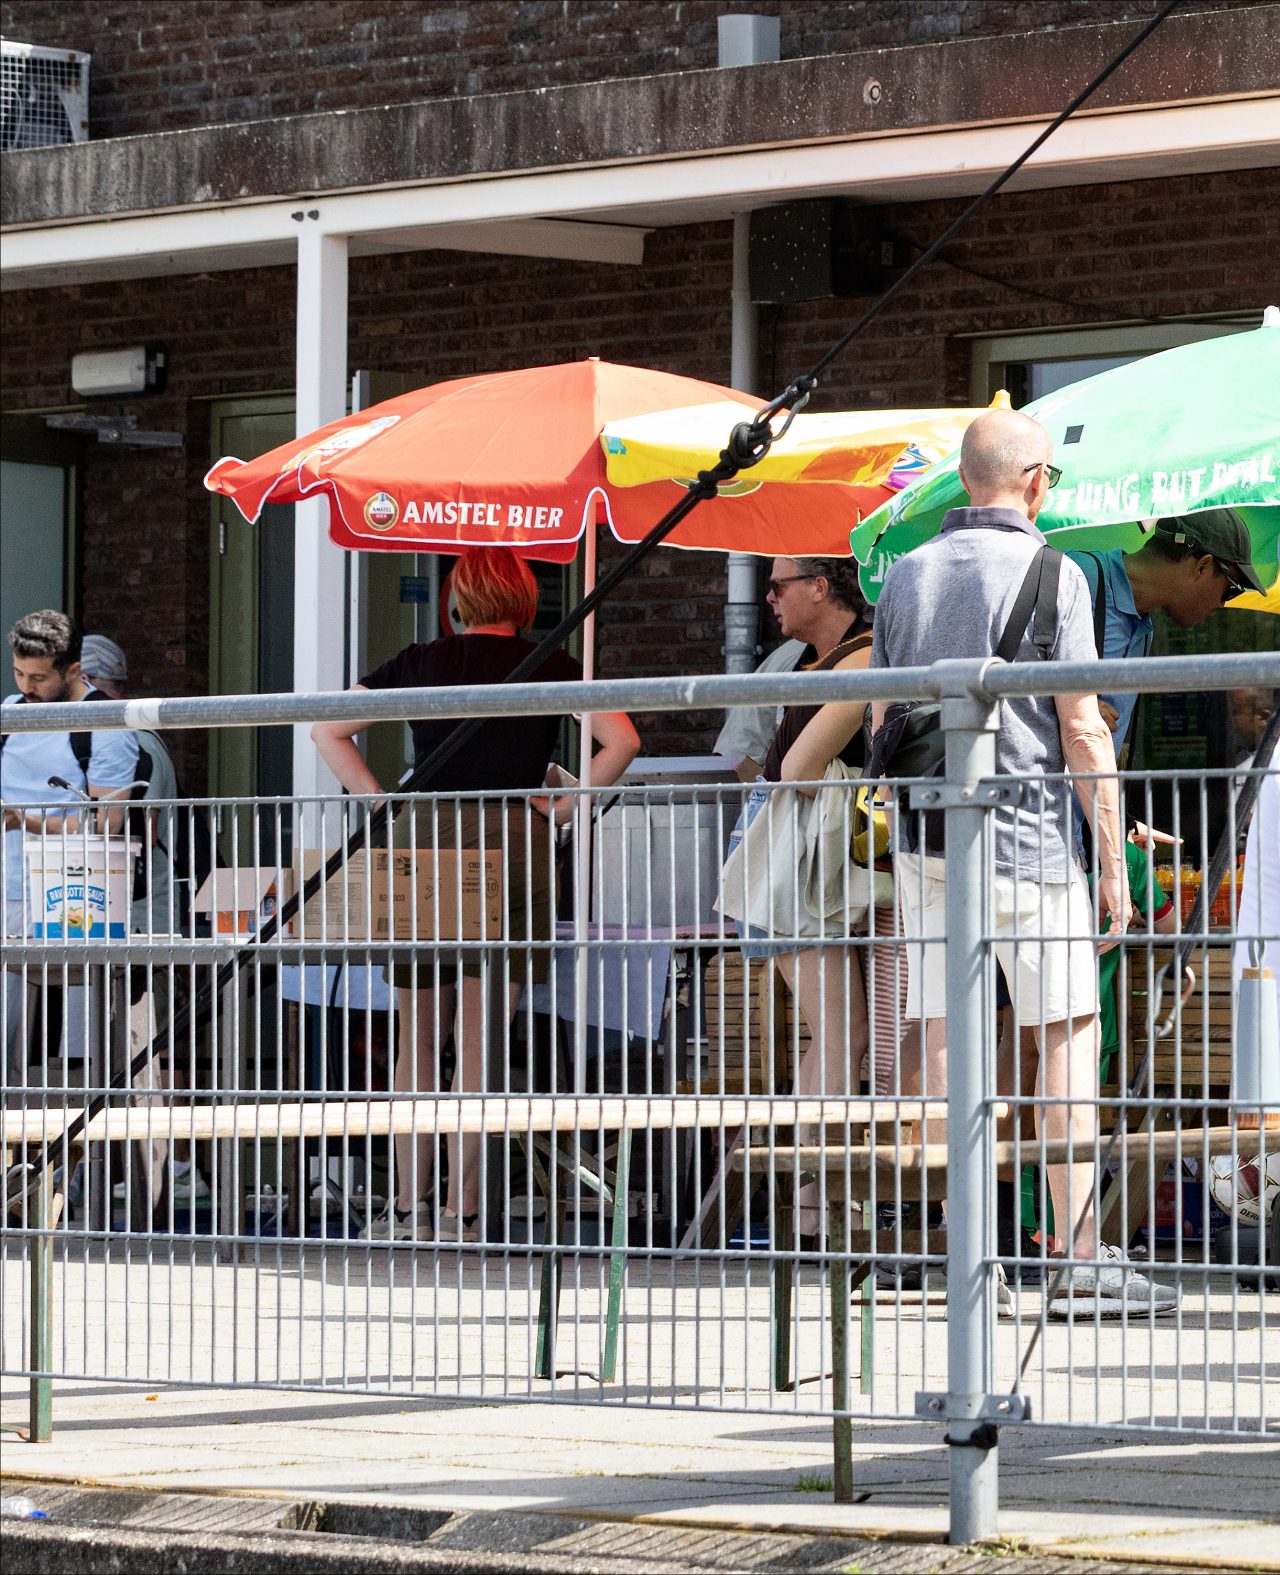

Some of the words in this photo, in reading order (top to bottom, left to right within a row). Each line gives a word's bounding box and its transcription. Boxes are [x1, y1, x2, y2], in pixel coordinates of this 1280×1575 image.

[1040, 473, 1140, 515] OTHING
[1151, 467, 1207, 504] BUT
[403, 501, 500, 526] AMSTEL
[507, 505, 564, 529] BIER
